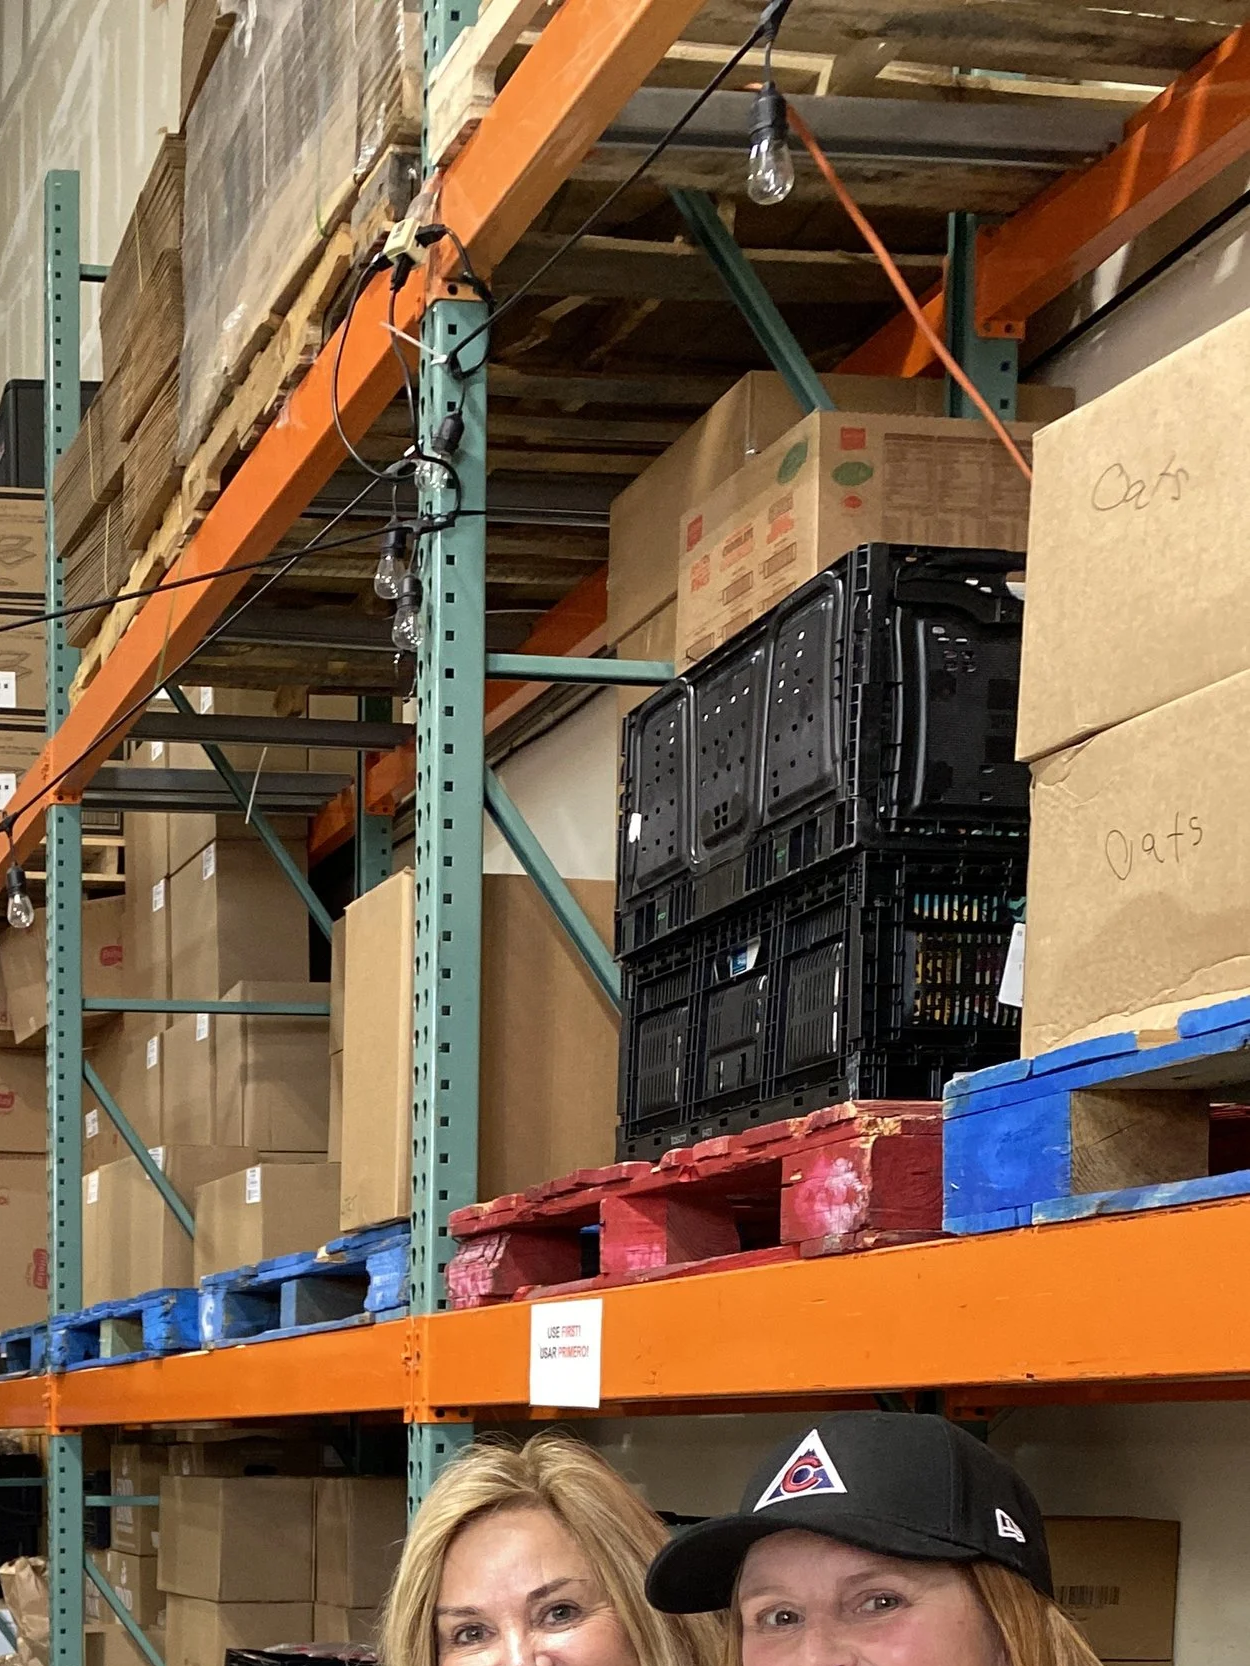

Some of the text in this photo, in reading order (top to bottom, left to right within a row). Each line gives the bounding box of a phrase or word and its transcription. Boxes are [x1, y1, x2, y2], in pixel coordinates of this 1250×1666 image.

[1091, 453, 1190, 512] Oats
[1104, 811, 1203, 881] Oats
[547, 1324, 582, 1339] USE FIRST!
[539, 1345, 590, 1360] USAR PRIMERO!
